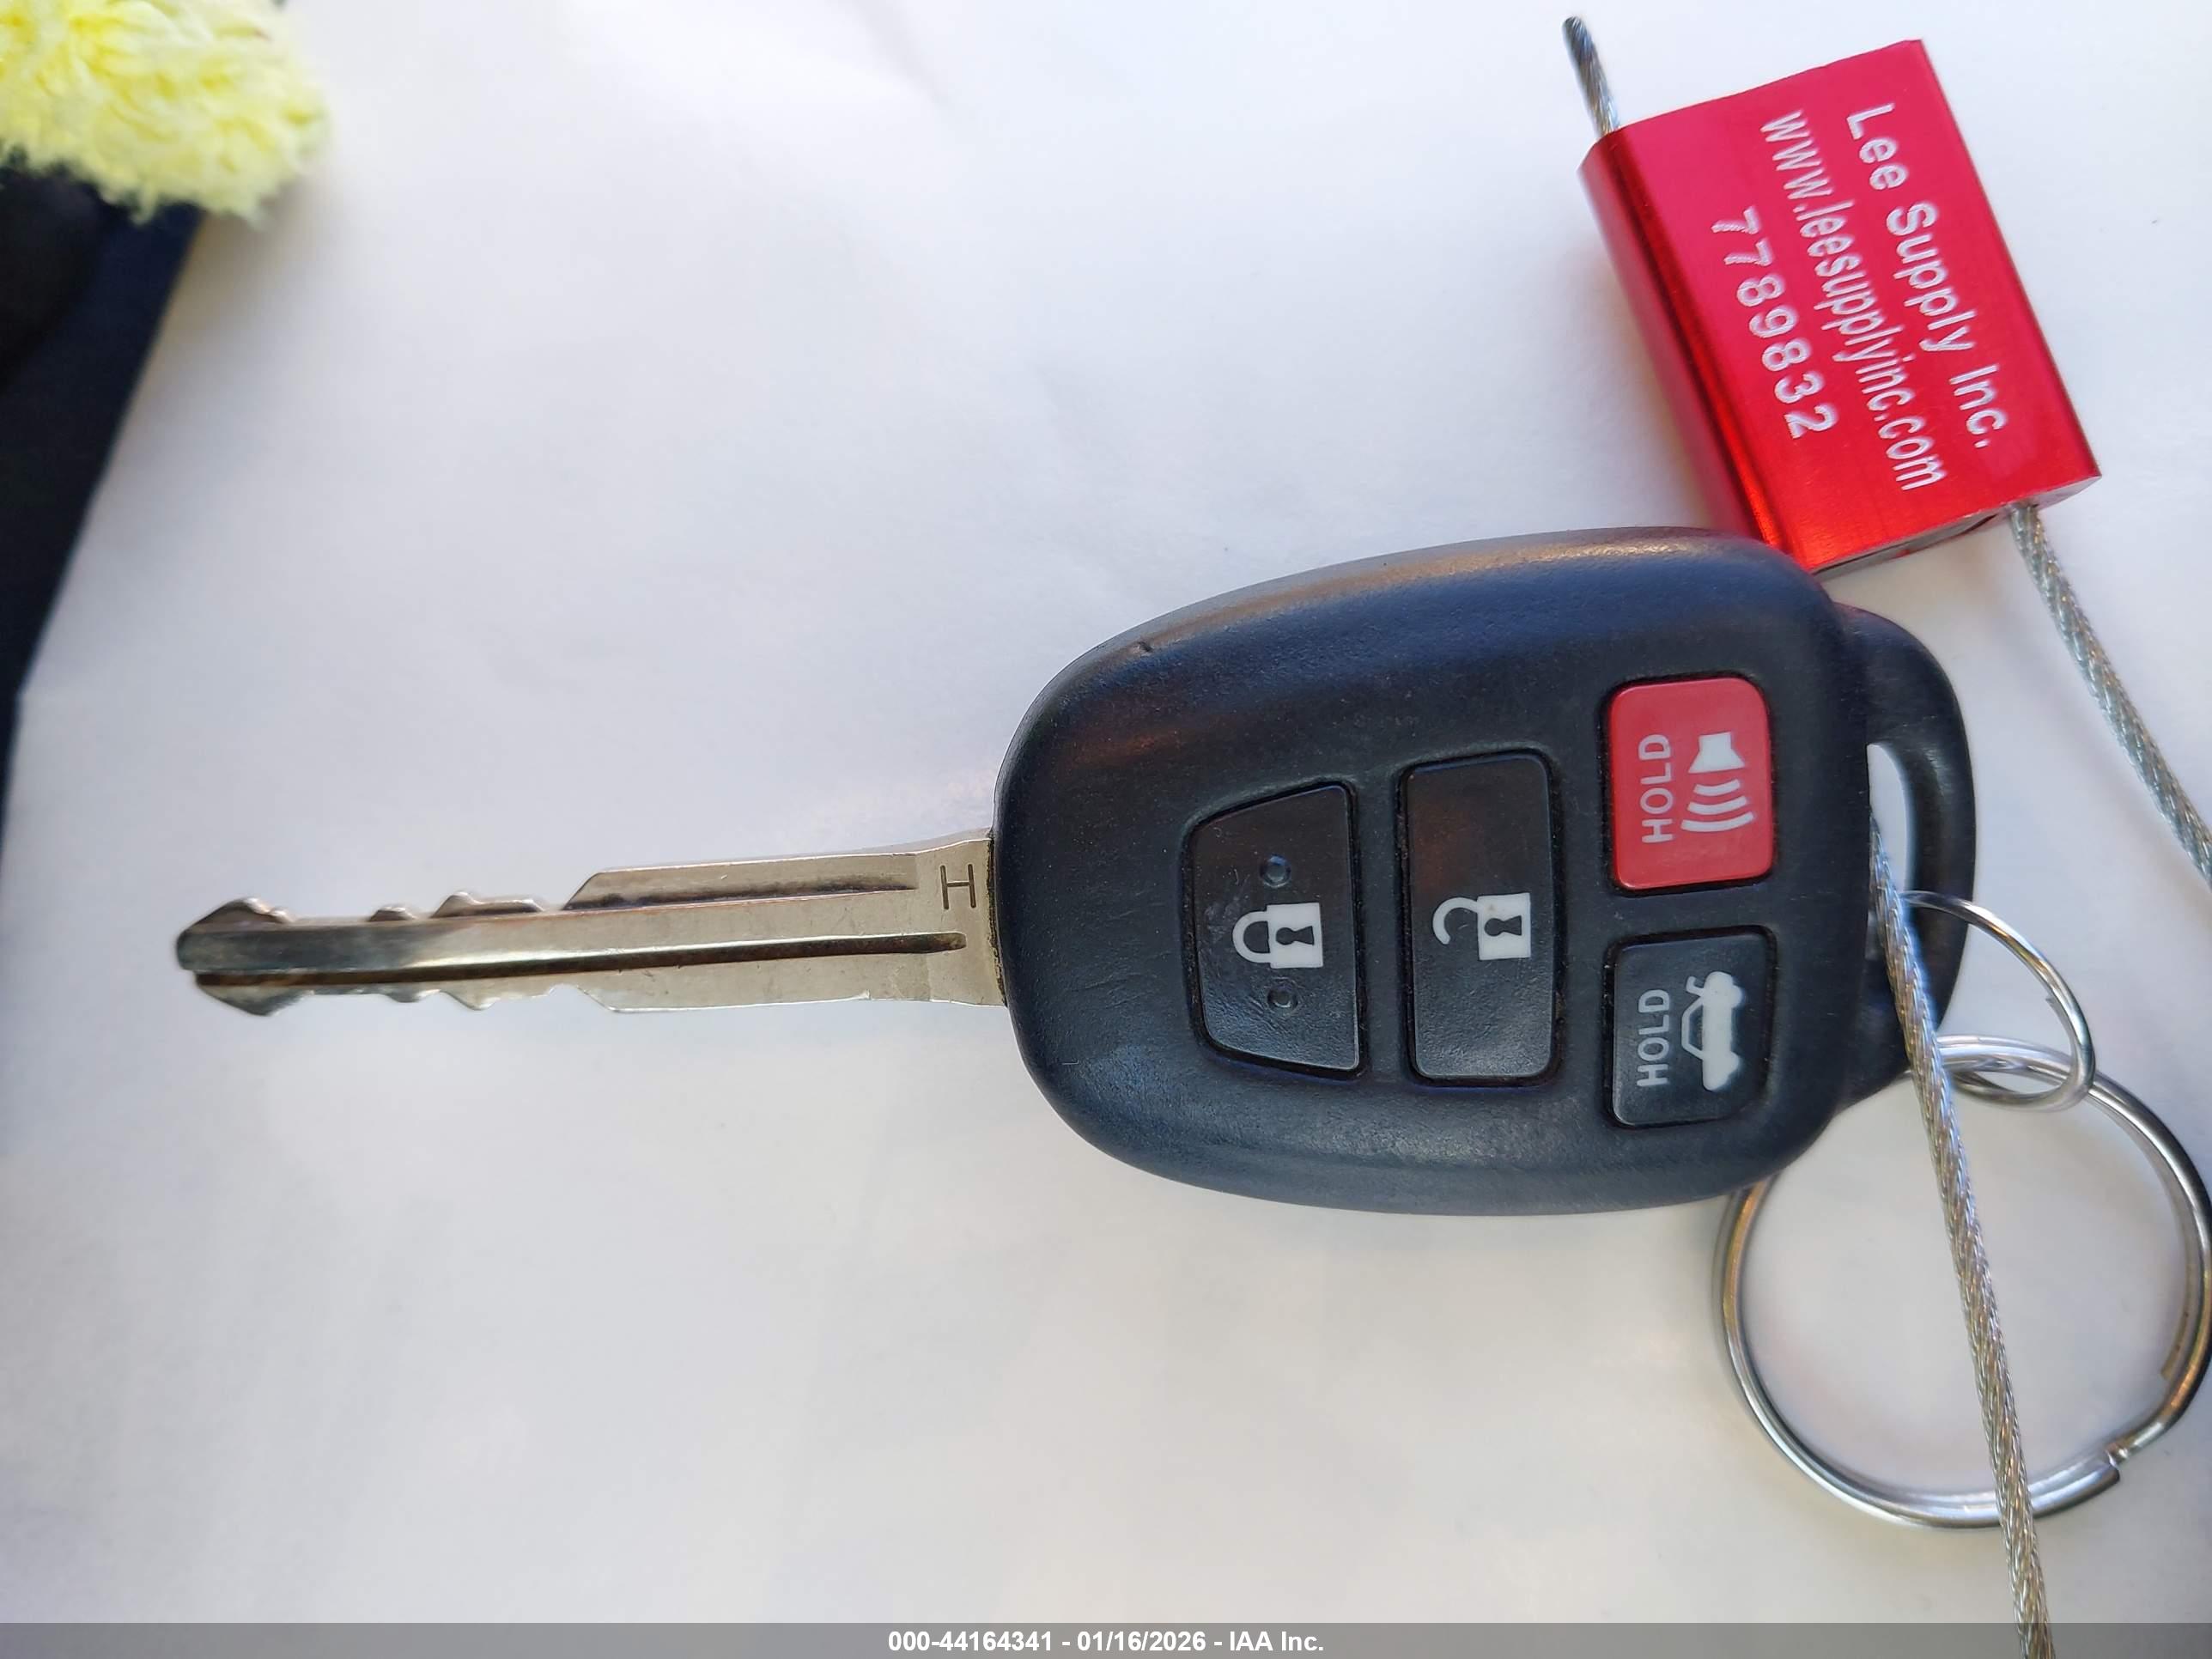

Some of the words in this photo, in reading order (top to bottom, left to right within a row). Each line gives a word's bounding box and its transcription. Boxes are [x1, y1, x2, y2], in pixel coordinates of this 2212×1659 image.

[1711, 206, 1839, 440] 7789832
[1761, 110, 1948, 492] www.leesupplyinc.com
[1846, 102, 1909, 191] Lee
[1885, 201, 1976, 352] Supply
[1950, 364, 2008, 450] Inc.
[1638, 733, 1674, 844] HOLD
[939, 864, 976, 910] H
[1637, 988, 1670, 1088] HOLD
